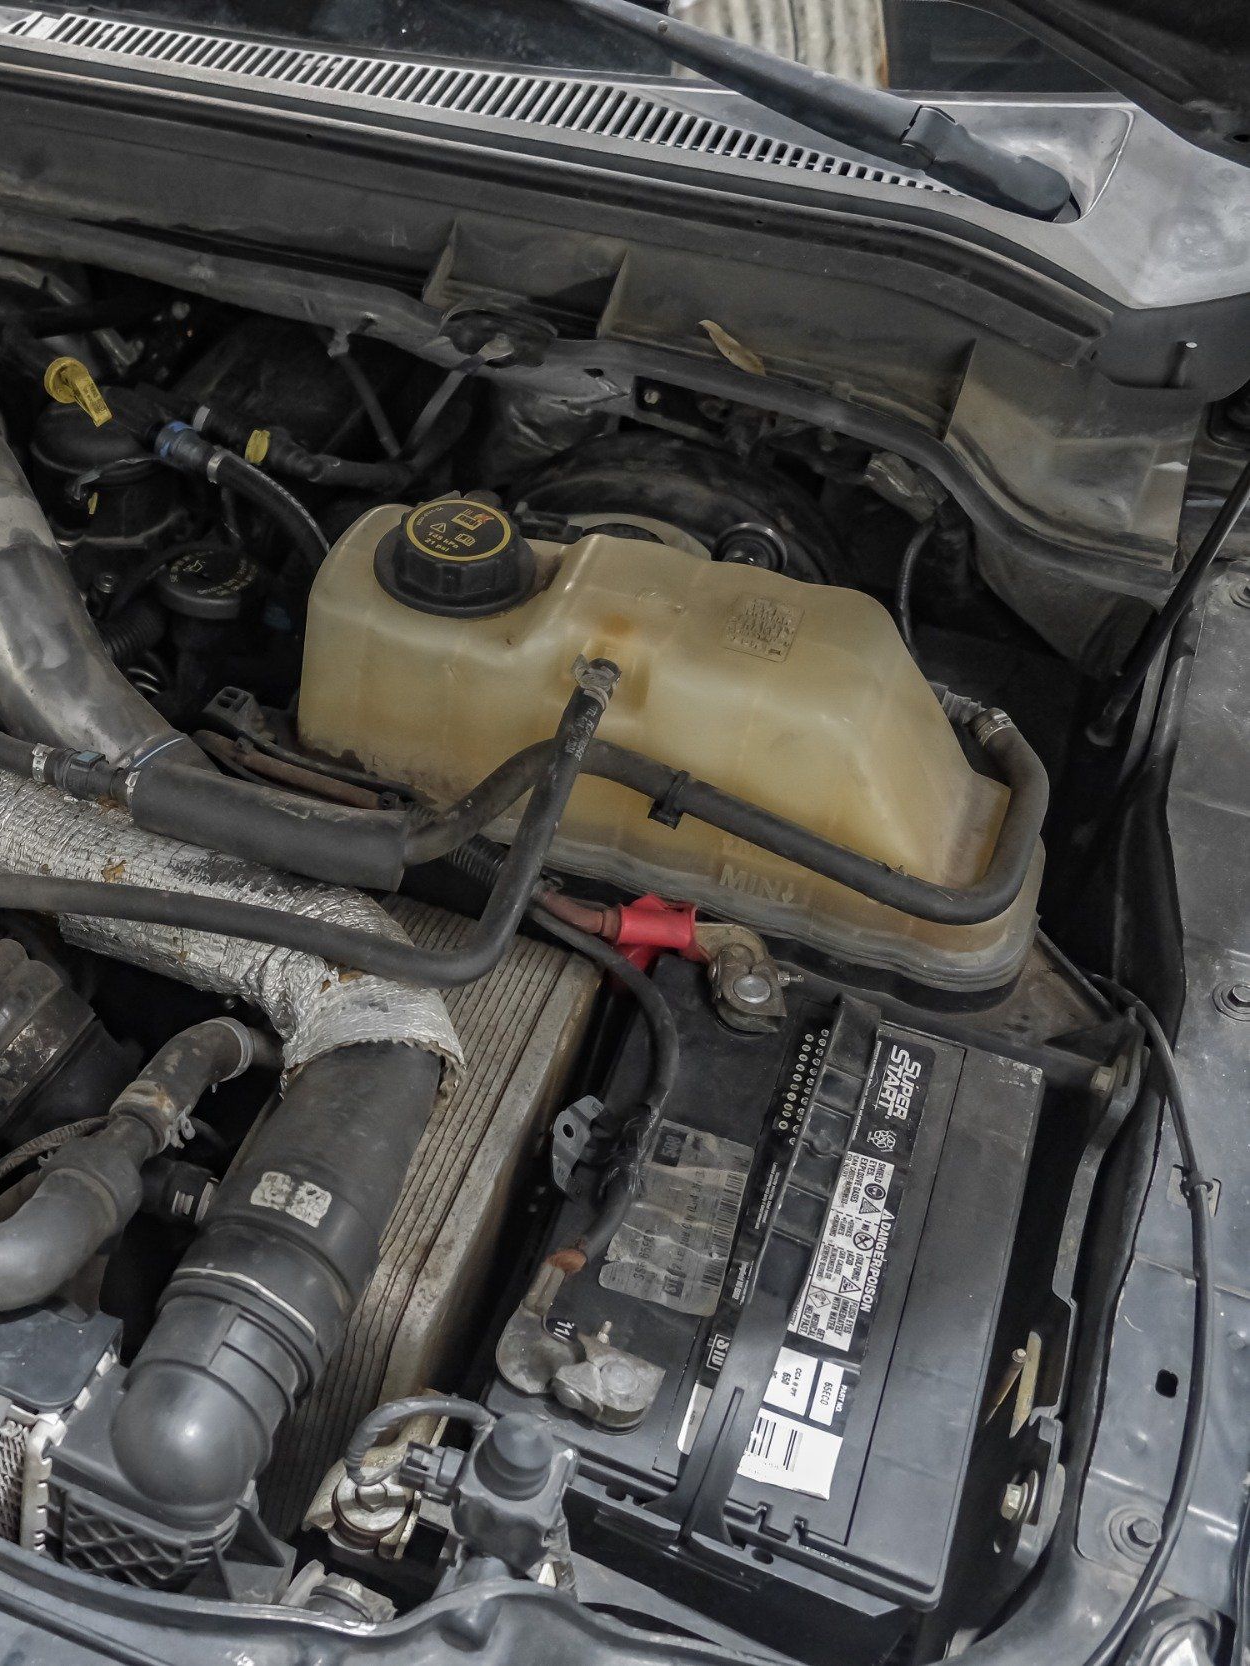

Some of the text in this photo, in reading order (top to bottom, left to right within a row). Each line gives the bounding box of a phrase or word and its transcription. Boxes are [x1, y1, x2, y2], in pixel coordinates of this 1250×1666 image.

[878, 1045, 910, 1118] START
[898, 1060, 922, 1120] SUPER
[849, 1157, 868, 1203] EXPLOSIVE GASES
[873, 1162, 886, 1183] SHIELD
[844, 1252, 854, 1265] ACID
[859, 1221, 889, 1313] DANGER/POISON
[831, 1296, 841, 1311] WITH
[806, 1312, 820, 1337] MEDICAL
[815, 1327, 825, 1340] GET
[843, 1319, 853, 1334] EYES
[779, 1372, 791, 1385] 650
